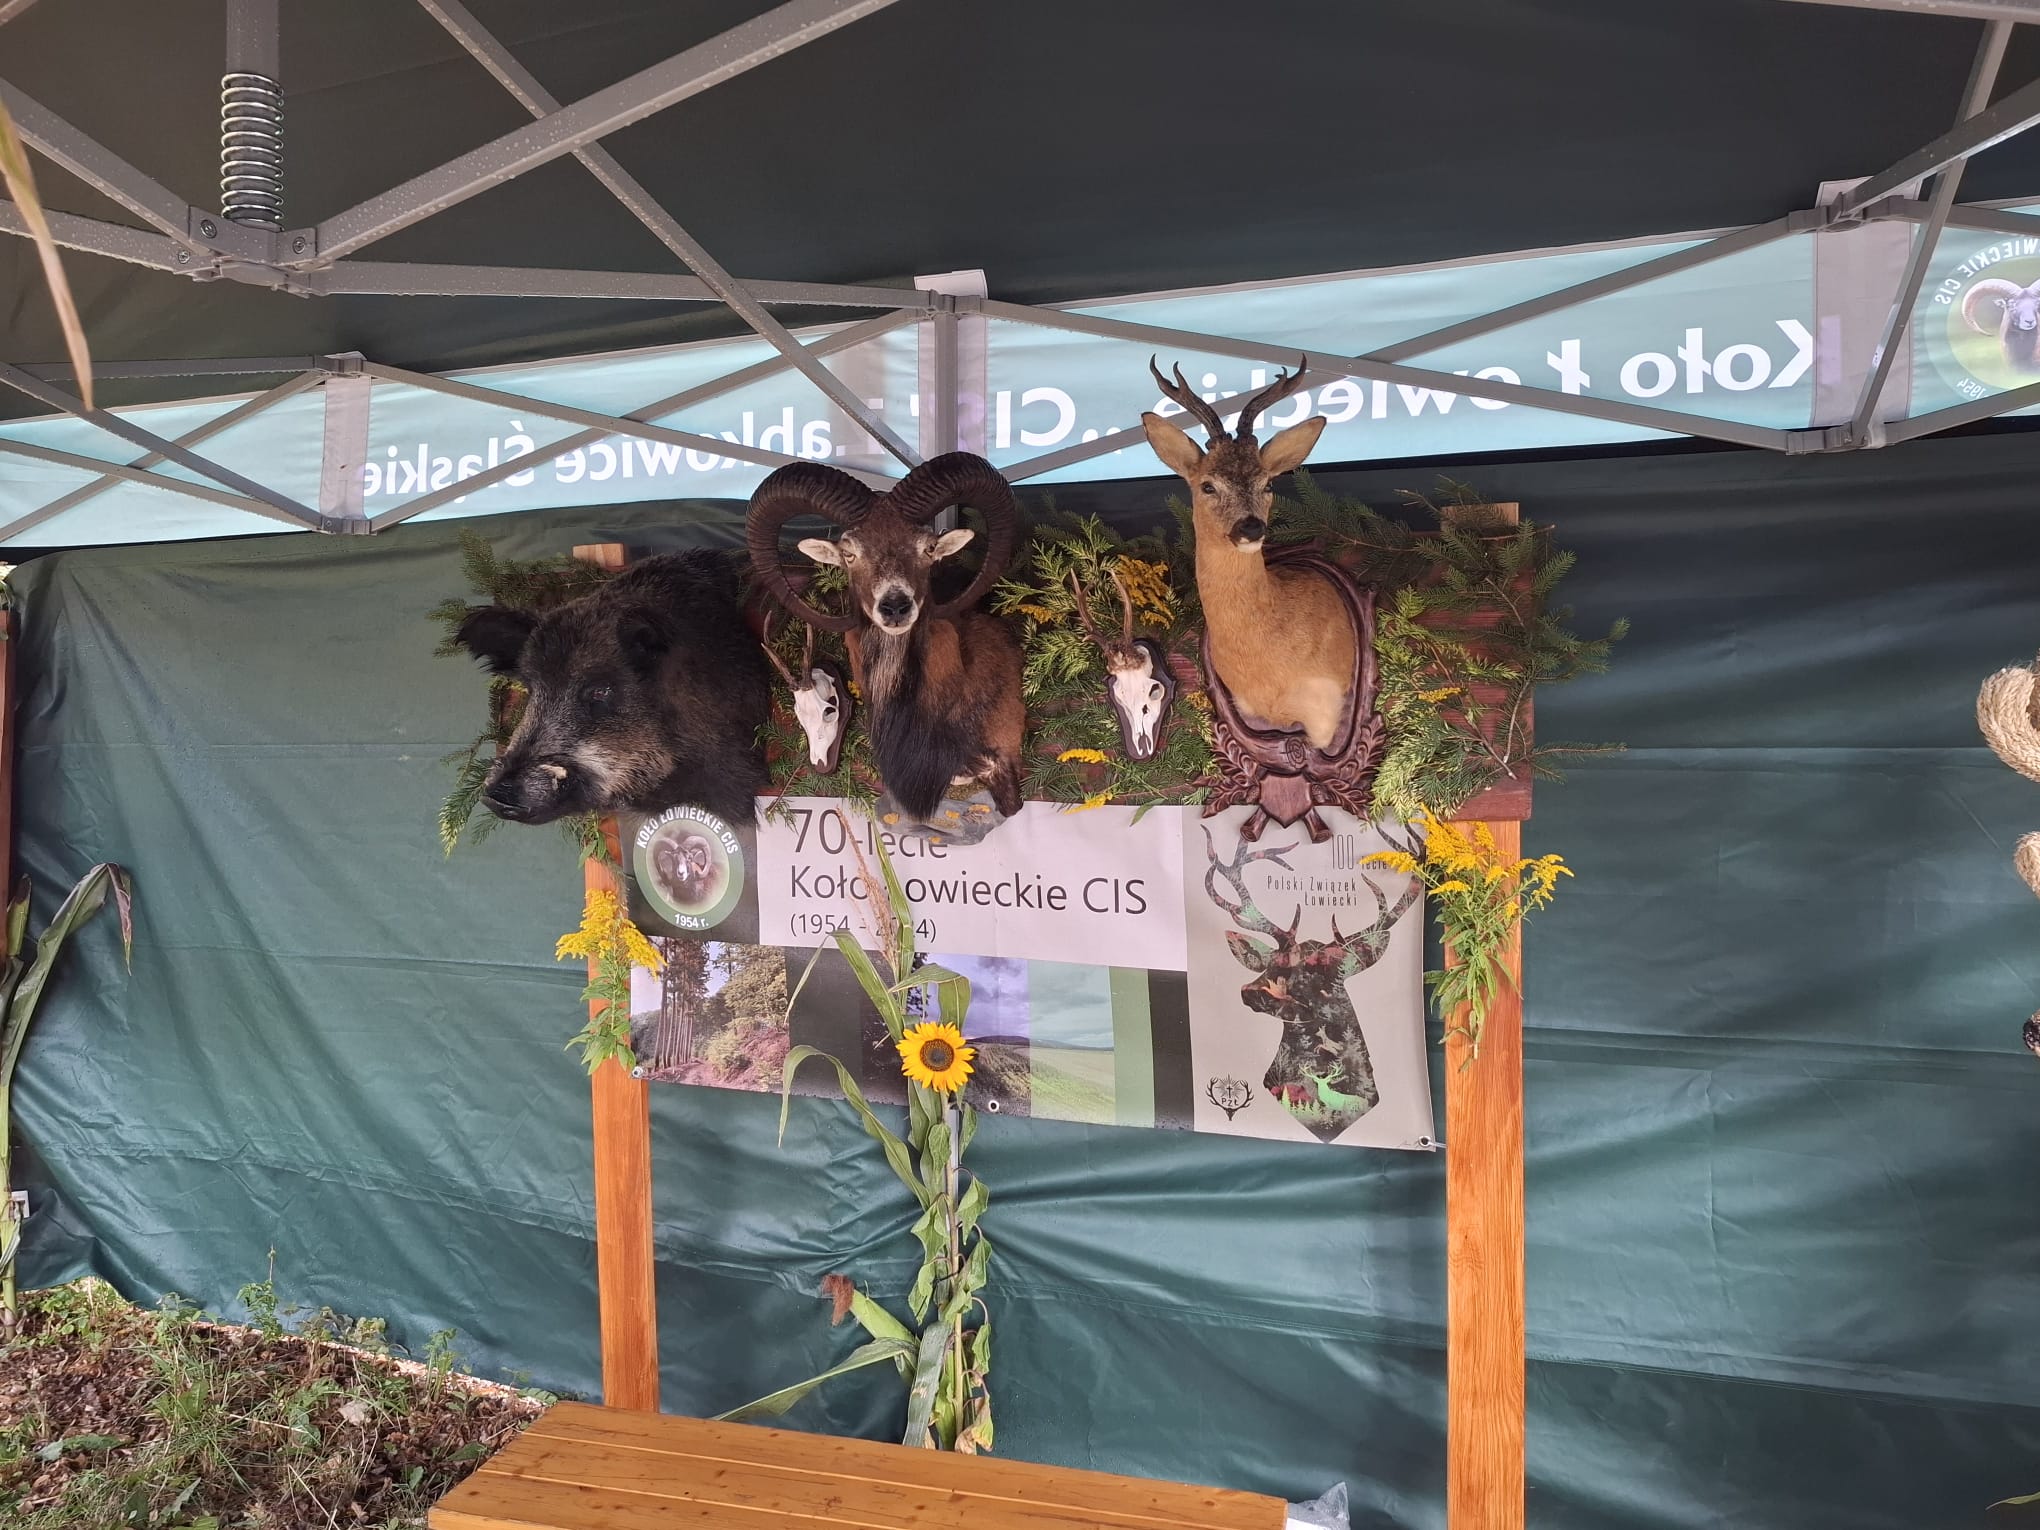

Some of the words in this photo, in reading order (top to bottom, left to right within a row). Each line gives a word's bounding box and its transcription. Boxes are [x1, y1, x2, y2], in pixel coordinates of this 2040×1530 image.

[637, 817, 659, 849] KOŁO
[660, 806, 723, 833] ŁOWIECKIE
[720, 832, 738, 854] CIS
[1332, 834, 1354, 870] 100
[791, 865, 868, 901] Koło
[884, 870, 1068, 911] owieckie
[1082, 876, 1148, 915] CIS
[1267, 875, 1303, 891] Polski
[1310, 876, 1357, 893] Związek
[674, 913, 699, 928] 1954
